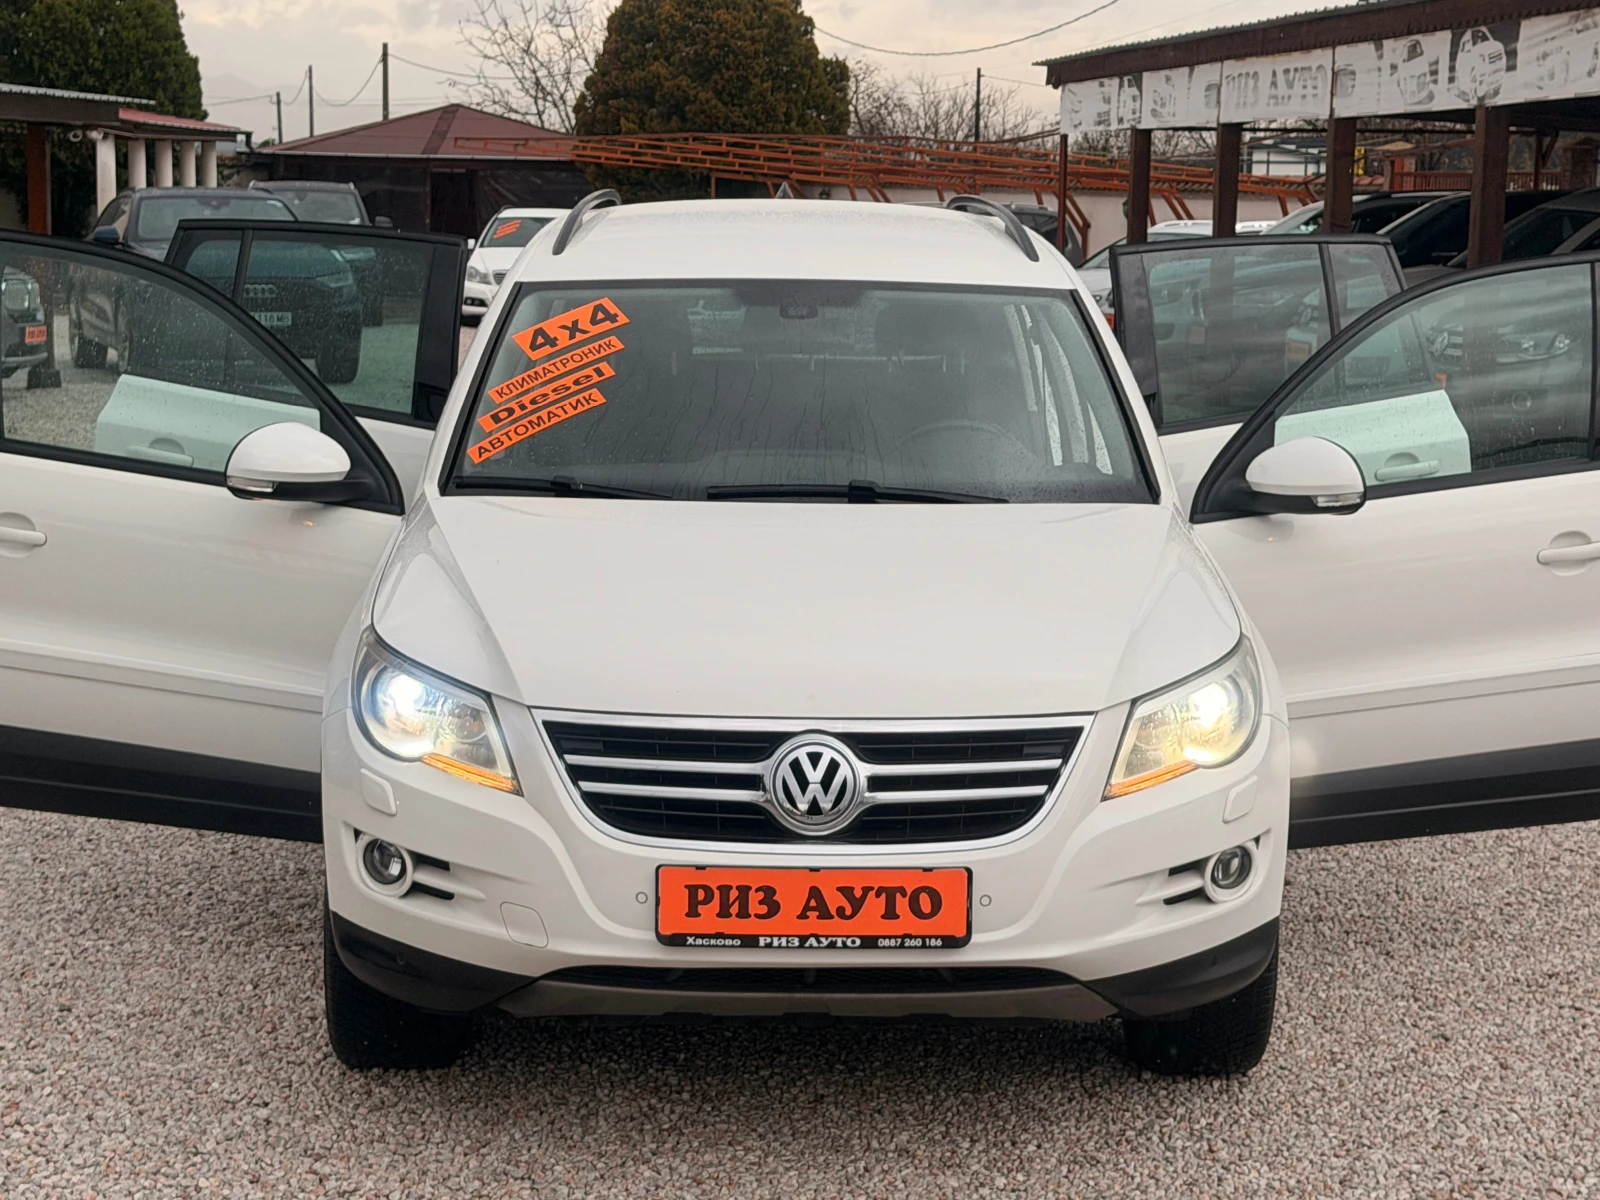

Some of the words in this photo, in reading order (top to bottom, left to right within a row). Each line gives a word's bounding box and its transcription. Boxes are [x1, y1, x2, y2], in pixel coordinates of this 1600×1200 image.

[529, 303, 619, 352] 4x4
[490, 367, 605, 425] Diesel
[495, 340, 617, 399] КЛИМАТРОНИК
[477, 393, 598, 458] АВТОМАТИК
[684, 884, 781, 919] РИЗ
[796, 885, 942, 920] АУТО
[686, 936, 741, 946] Хасково
[758, 937, 799, 947] РИЗ
[804, 937, 861, 947] АУТО
[877, 938, 901, 947] 0887
[904, 938, 922, 947] 260
